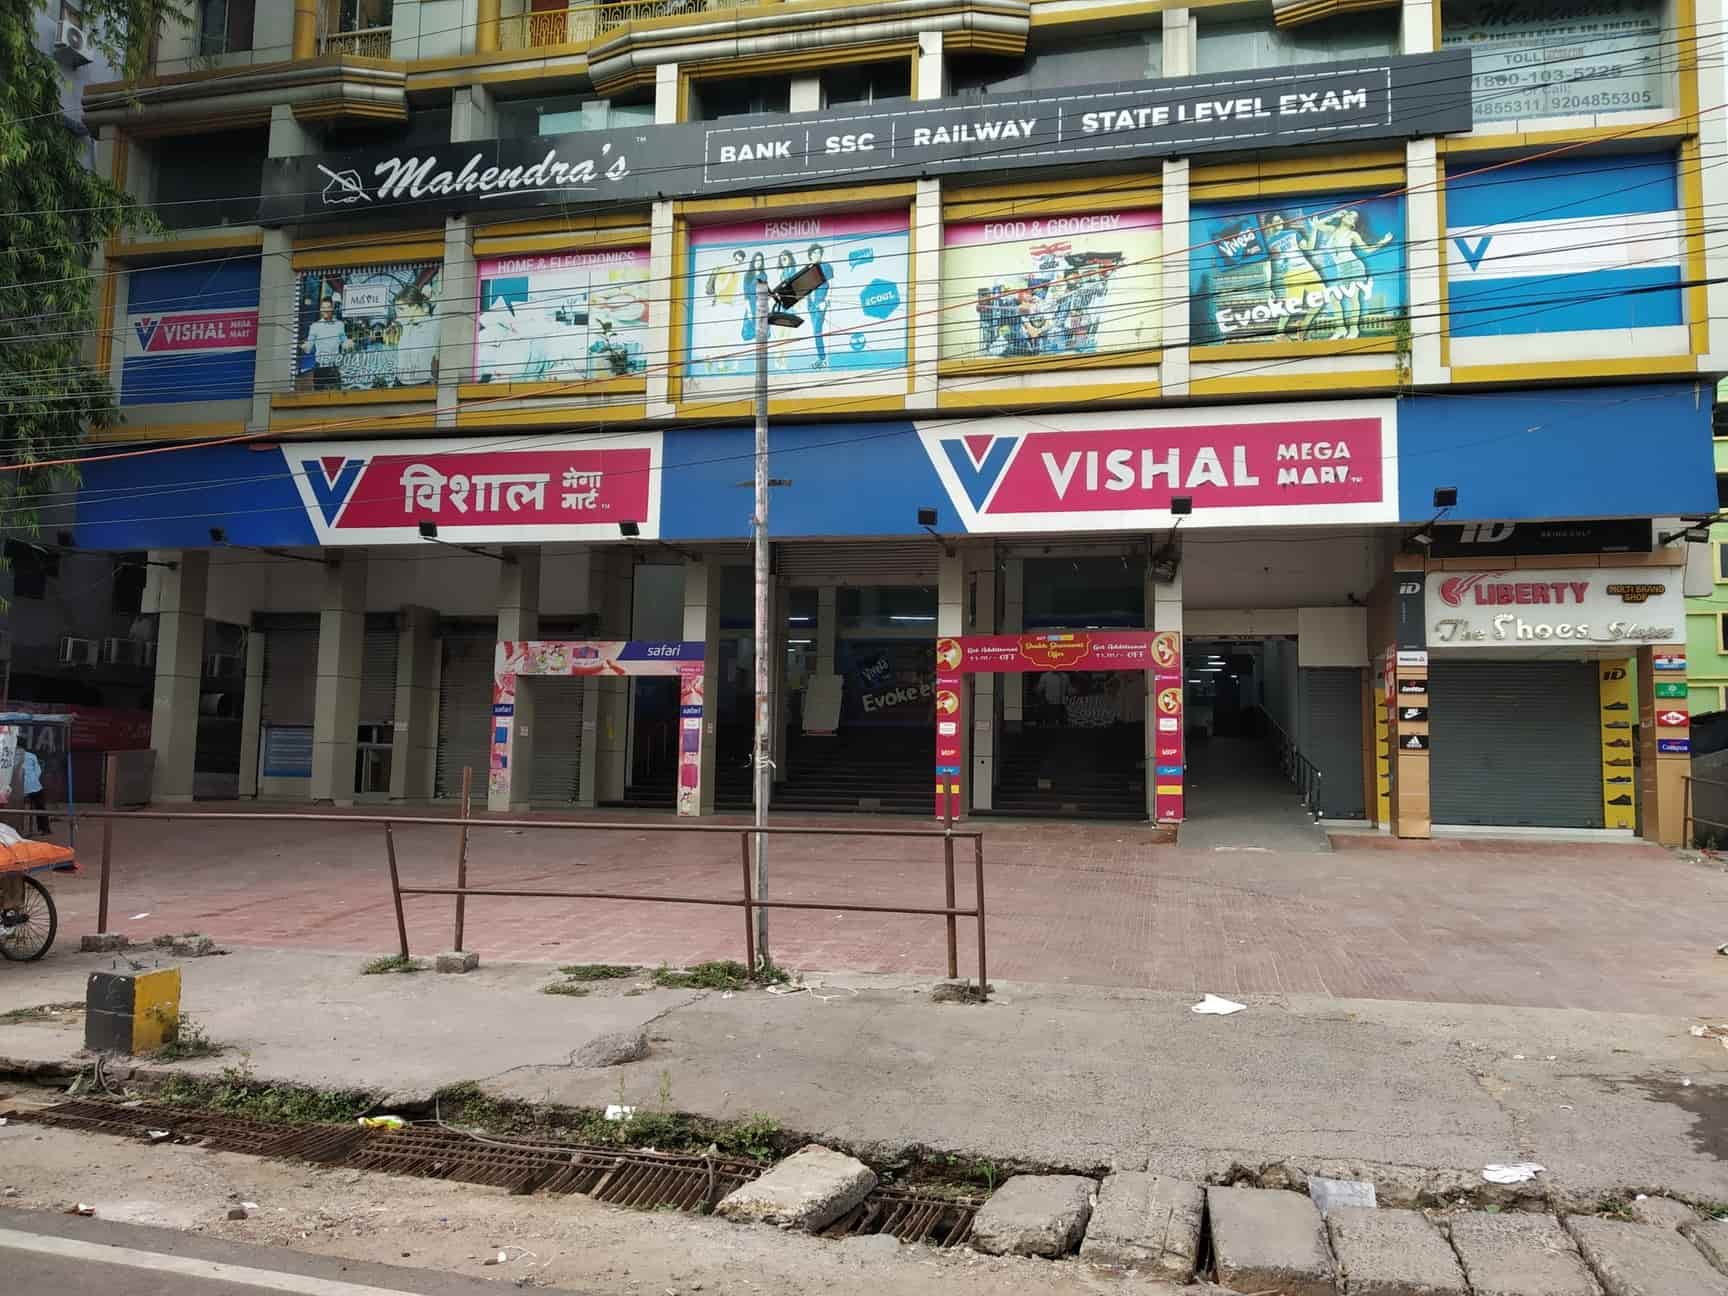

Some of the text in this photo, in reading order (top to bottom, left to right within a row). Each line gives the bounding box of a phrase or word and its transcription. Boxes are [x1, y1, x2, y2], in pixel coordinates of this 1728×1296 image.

[1503, 53, 1541, 65] TOLL
[1082, 88, 1368, 133] STATE LEVEL EXAM
[825, 132, 875, 154] SSC
[913, 119, 1036, 147] RAILWAY
[719, 140, 792, 163] BANK
[374, 143, 630, 199] Mahendra's
[764, 219, 822, 236] FASHION
[984, 215, 1121, 240] FOOD & GROCERY
[498, 257, 535, 274] HOME
[550, 250, 635, 269] ELECTRONICS
[1216, 277, 1374, 333] Evoke envy
[163, 321, 226, 344] VISHAL
[1276, 441, 1352, 462] MEGA
[1041, 446, 1259, 500] VISHAL
[399, 464, 551, 514] विशाल
[1474, 581, 1590, 606] LIBERTY
[646, 645, 682, 657] safari
